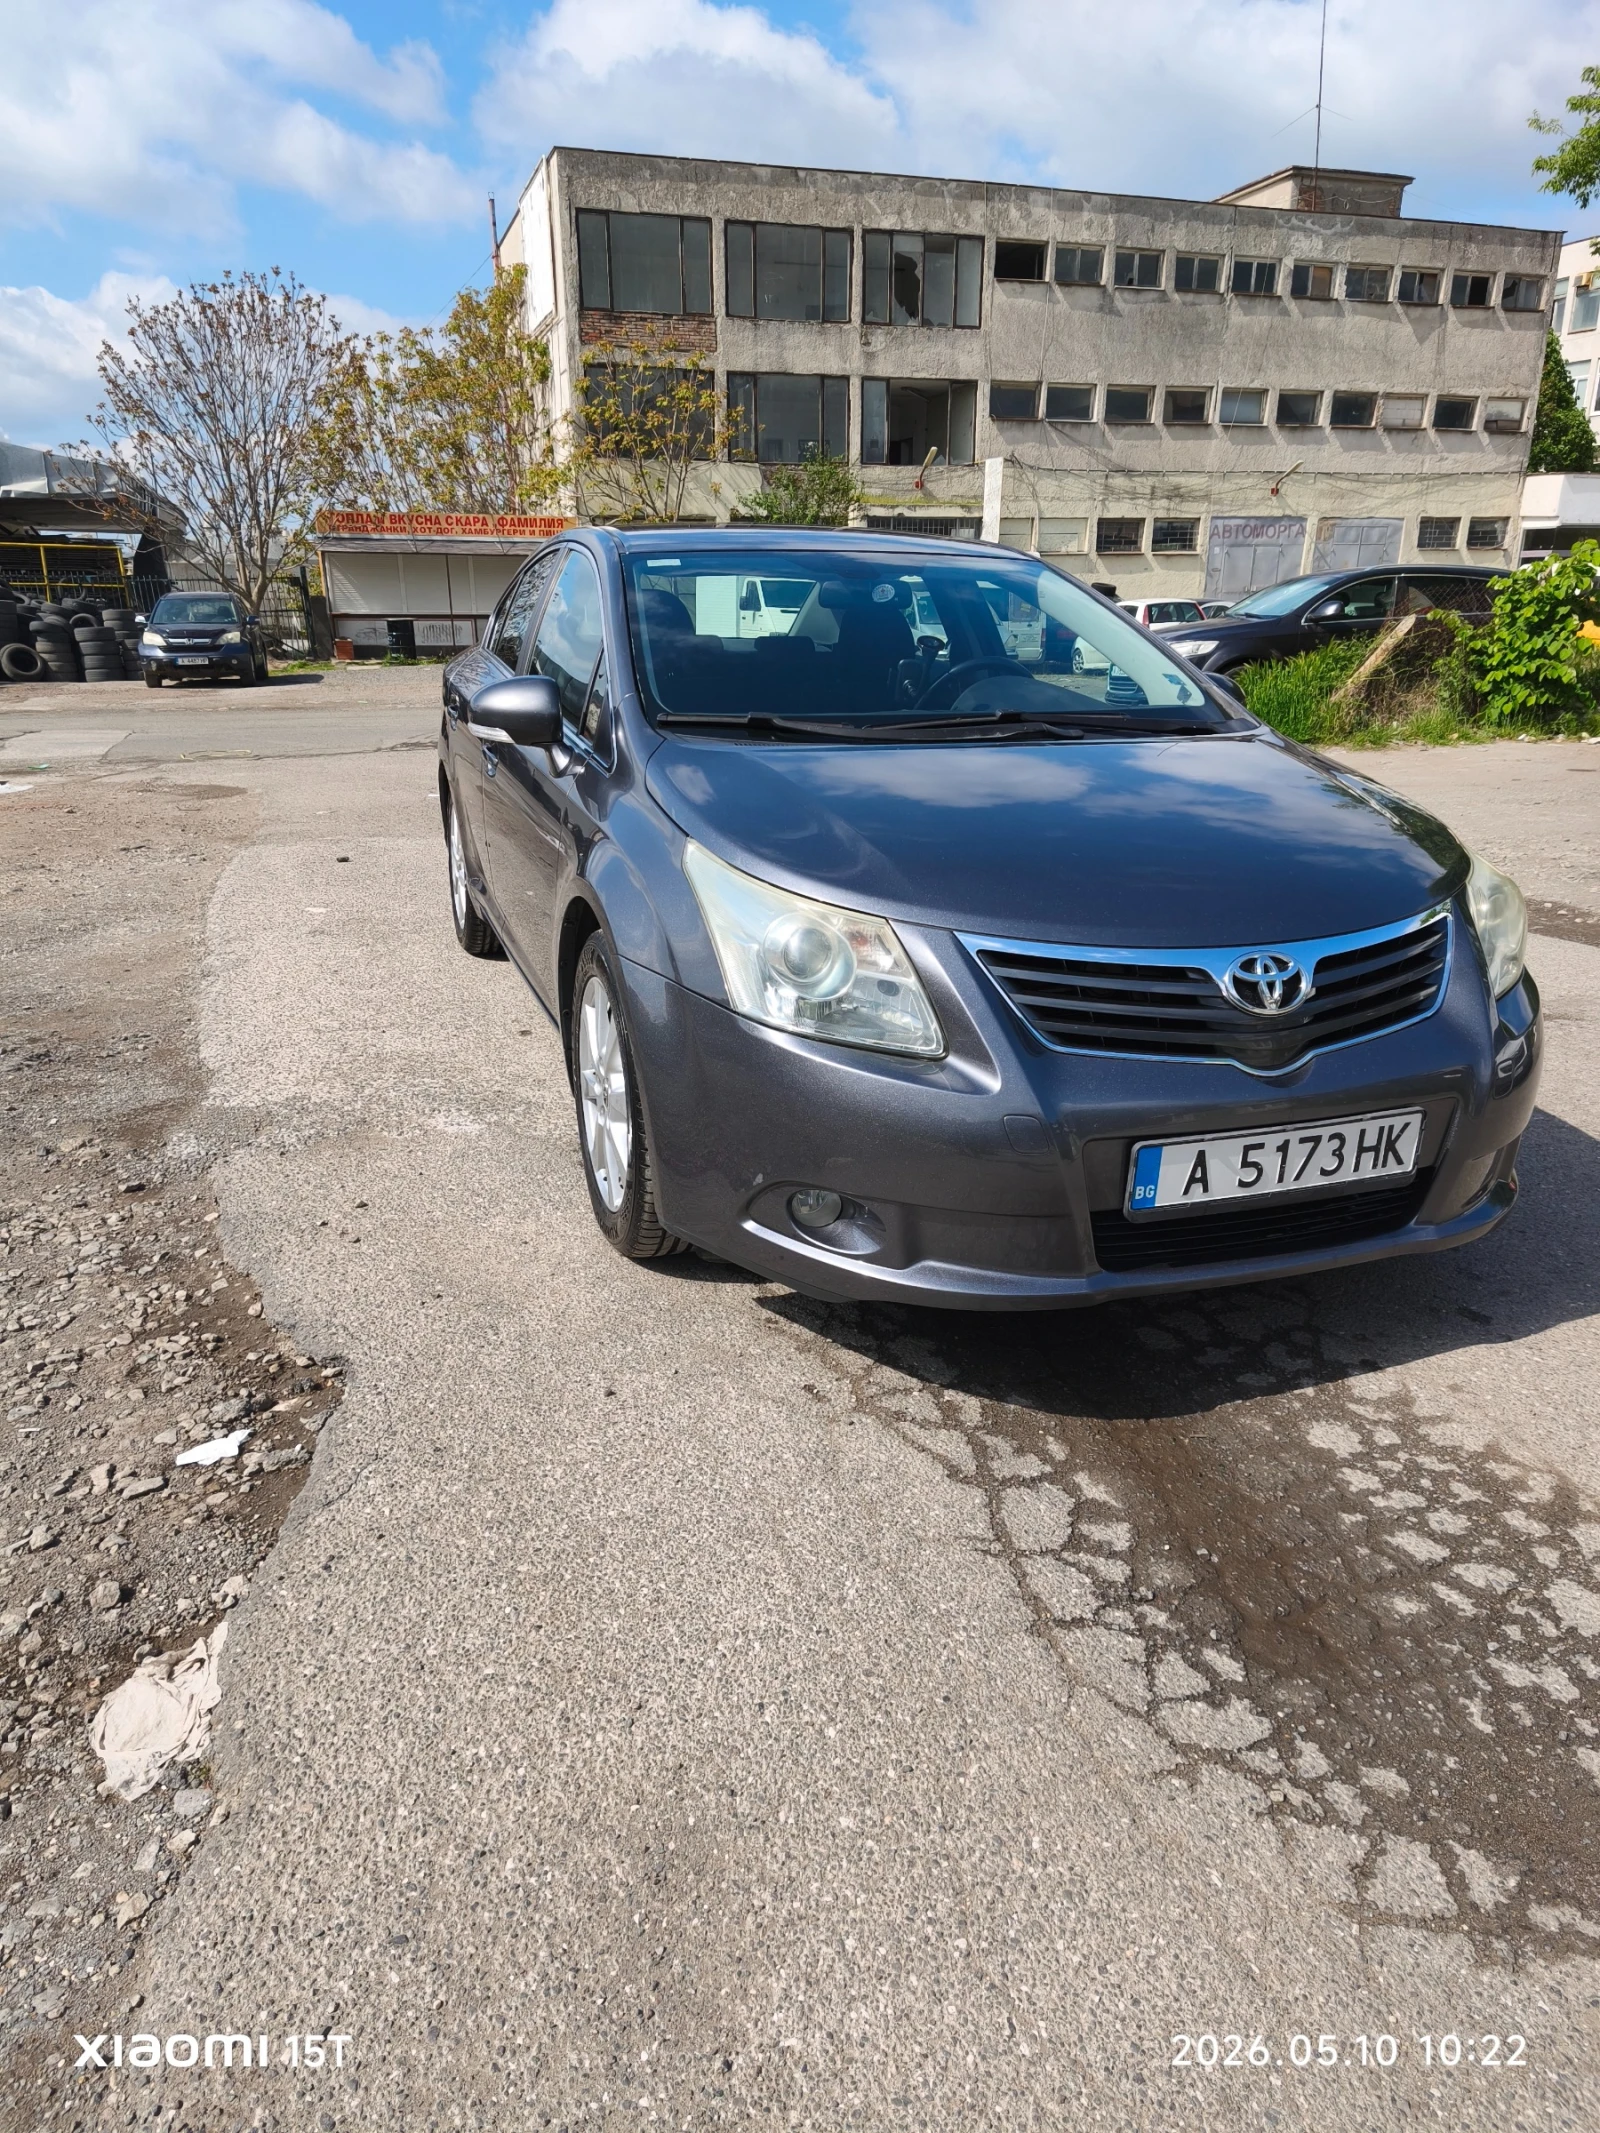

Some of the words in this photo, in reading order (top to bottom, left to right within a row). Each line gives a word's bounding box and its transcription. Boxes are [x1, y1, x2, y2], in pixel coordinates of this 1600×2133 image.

[389, 513, 442, 526] ВКУСНА
[445, 515, 489, 527] СКАРА
[461, 527, 526, 537] ХАМБУРГЕРИ
[1209, 523, 1306, 540] АВТОМОРГА
[1181, 1149, 1210, 1197] A
[1135, 1184, 1155, 1200] BG
